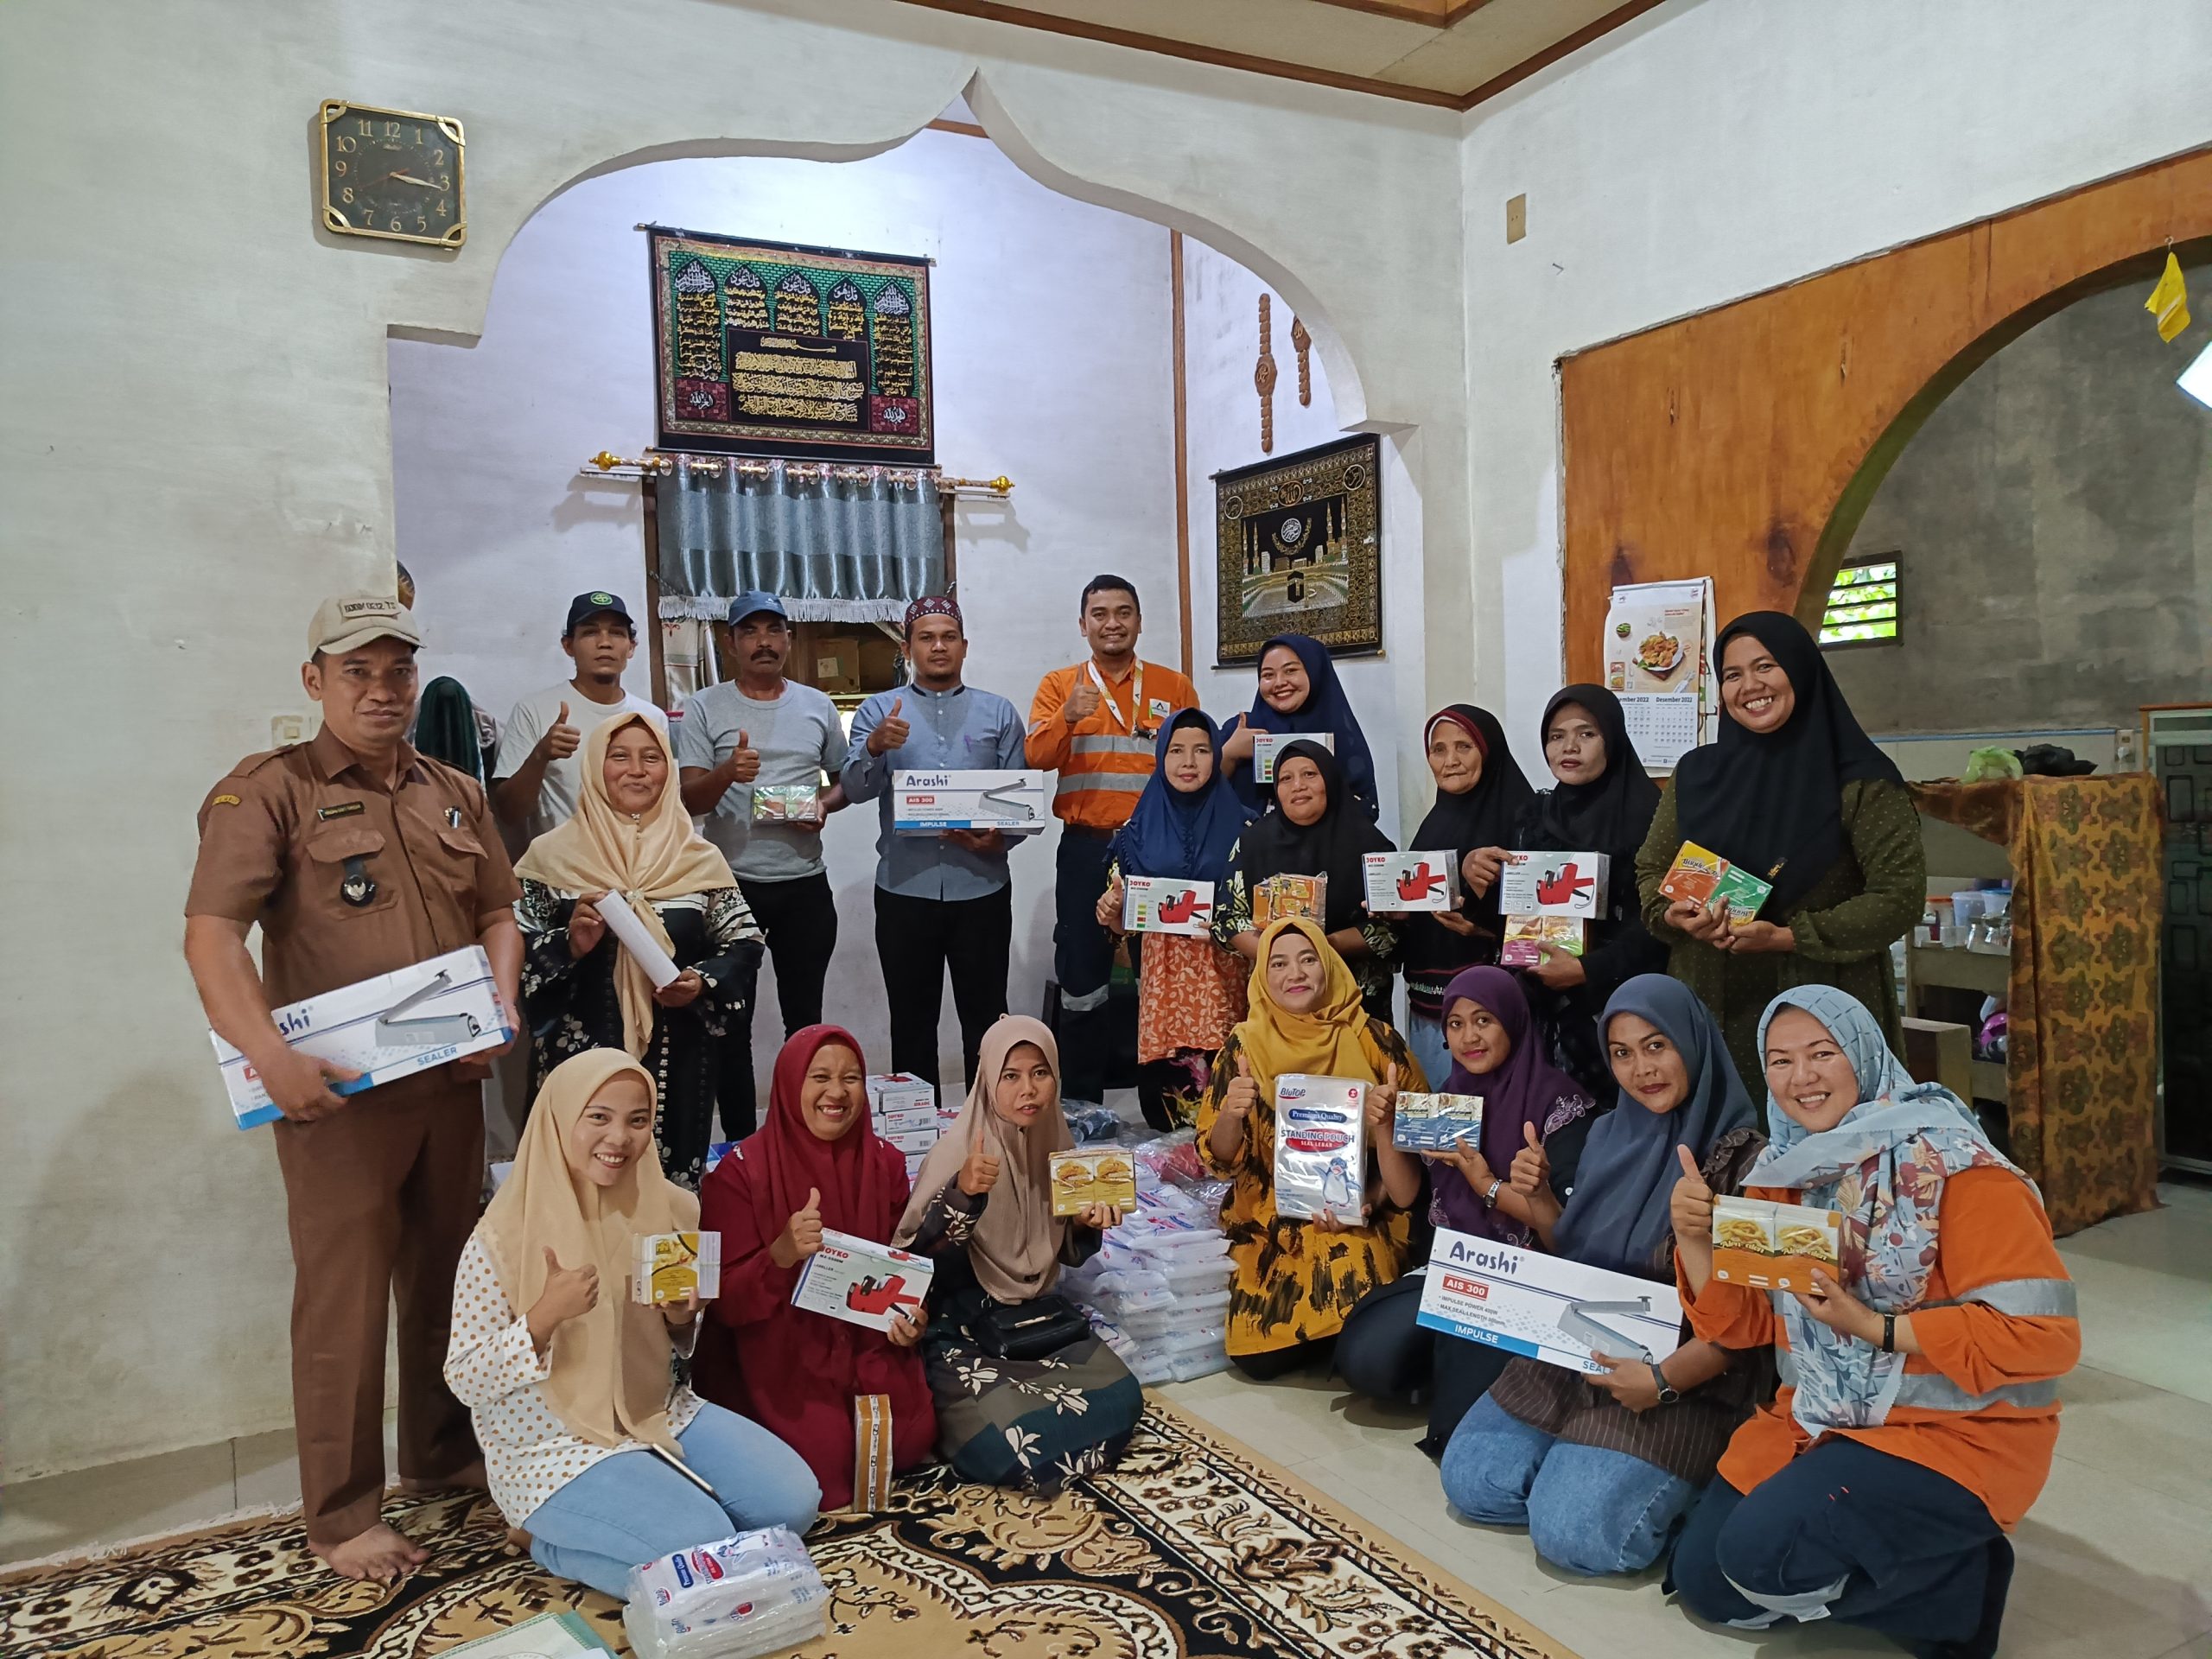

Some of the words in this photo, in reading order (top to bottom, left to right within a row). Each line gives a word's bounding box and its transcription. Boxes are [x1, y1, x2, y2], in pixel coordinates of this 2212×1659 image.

[358, 119, 373, 137] 11
[384, 122, 401, 138] 12
[336, 136, 357, 153] 10
[415, 129, 423, 144] 1
[434, 149, 444, 166] 2
[335, 161, 346, 177] 9
[441, 175, 450, 191] 3
[342, 188, 354, 204] 8
[435, 200, 447, 216] 4
[363, 209, 373, 226] 7
[391, 216, 402, 232] 6
[416, 216, 426, 232] 5
[906, 774, 948, 786] Arashi
[279, 1008, 310, 1035] shi
[416, 1046, 457, 1066] SEALER
[1281, 1129, 1323, 1140] STANDING
[1325, 1133, 1355, 1143] POUCH
[1449, 1241, 1518, 1274] Arashi
[1446, 1279, 1465, 1290] AIS
[1466, 1284, 1485, 1296] 300
[1442, 1295, 1464, 1306] IMPULSE
[1465, 1301, 1484, 1312] POWER
[1466, 1311, 1487, 1321] LENGTH
[1454, 1324, 1498, 1344] IMPULSE
[1583, 1360, 1611, 1375] SEAL
